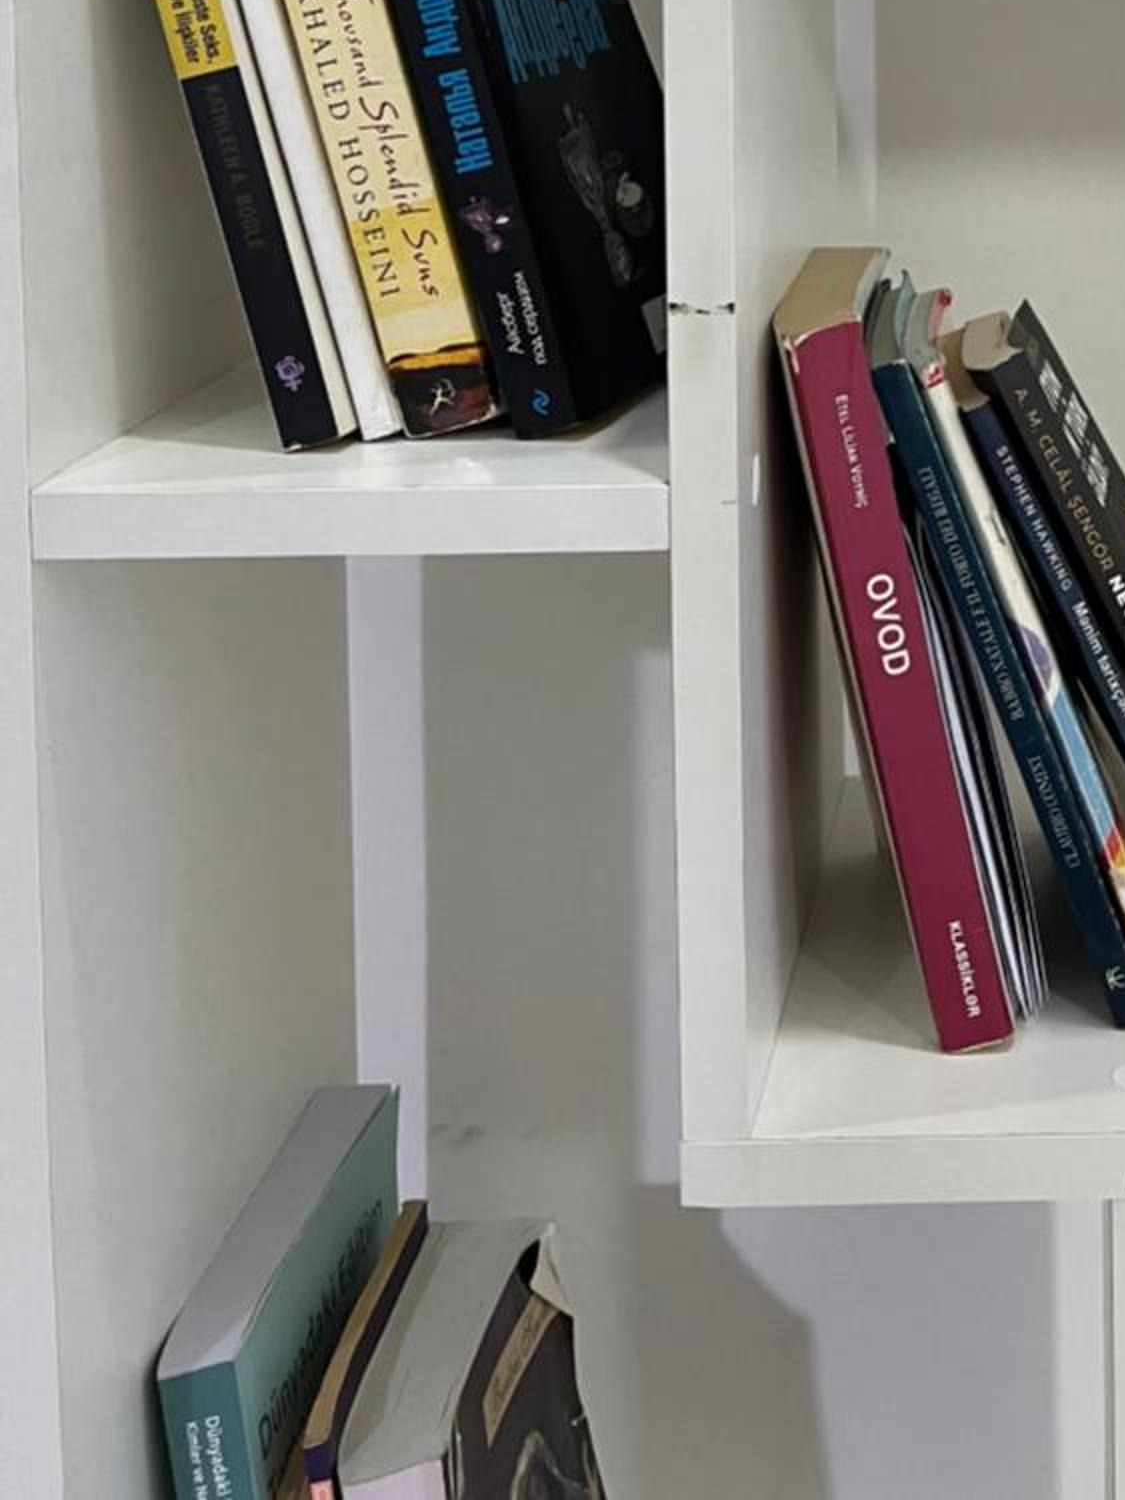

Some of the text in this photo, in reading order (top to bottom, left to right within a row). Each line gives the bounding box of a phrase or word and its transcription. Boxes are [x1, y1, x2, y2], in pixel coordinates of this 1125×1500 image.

[438, 68, 493, 174] Наталья
[339, 137, 400, 298] HOSSEINI
[358, 96, 430, 216] Splendid
[402, 228, 440, 298] Suns
[1014, 387, 1029, 408] A.
[1026, 409, 1042, 432] M.
[996, 444, 1072, 592] STEPHEN HAWKING
[866, 573, 911, 676] OVOD
